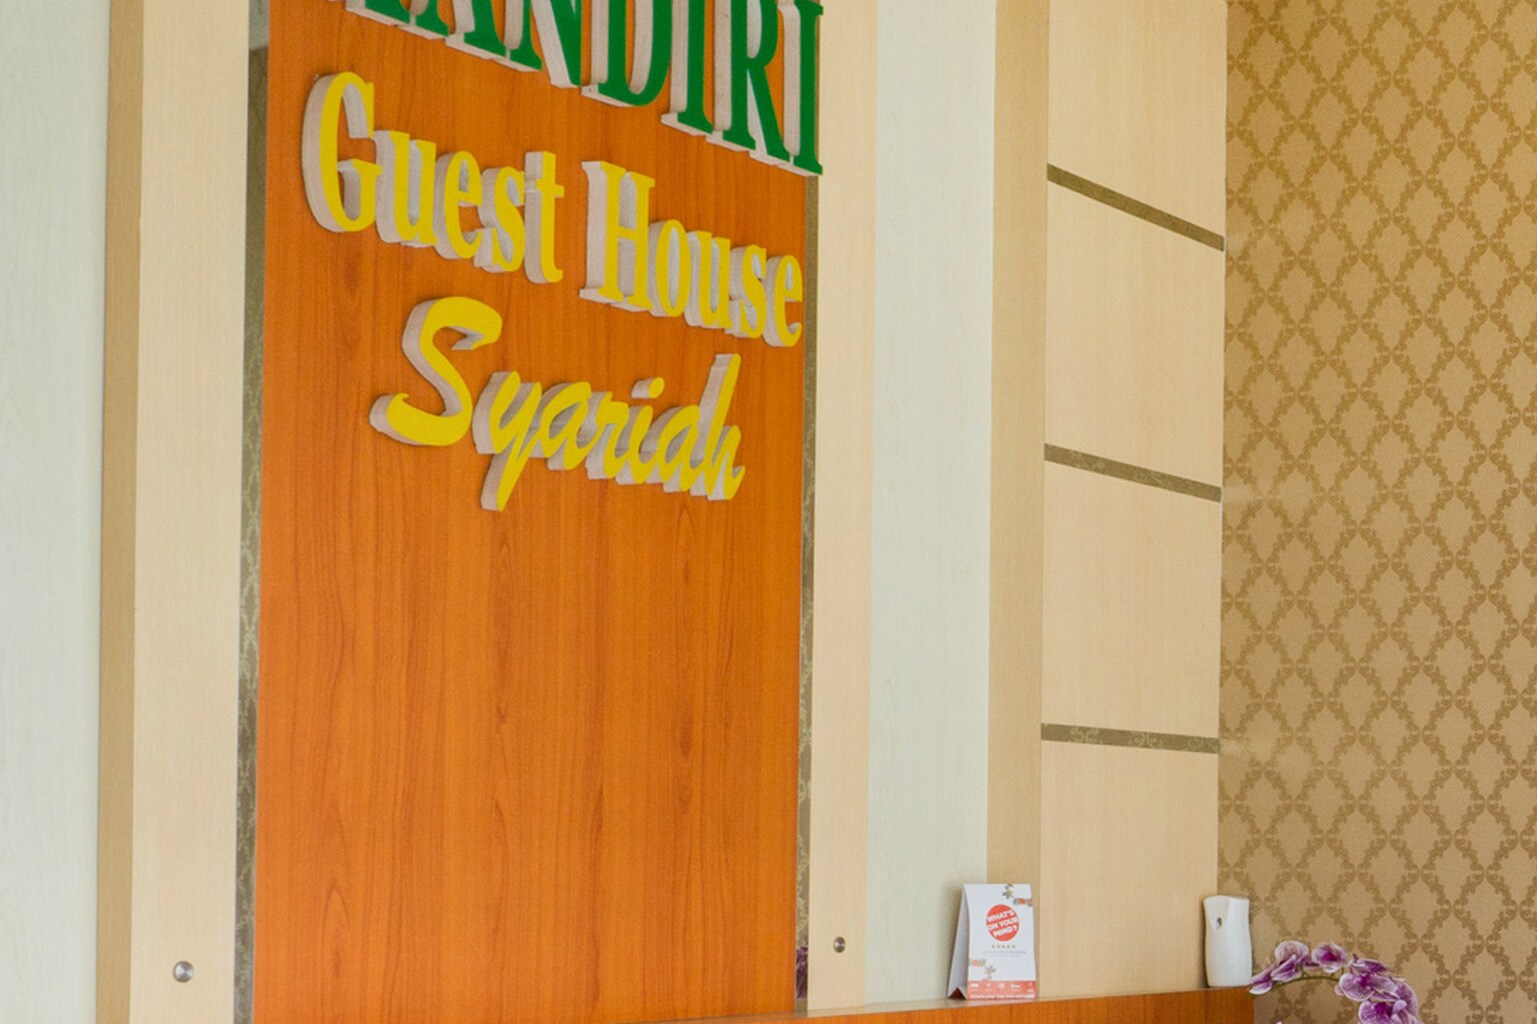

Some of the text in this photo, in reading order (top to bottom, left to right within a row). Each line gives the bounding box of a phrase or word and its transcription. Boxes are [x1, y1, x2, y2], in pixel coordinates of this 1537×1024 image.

[302, 71, 803, 347] Guest House
[369, 296, 746, 512] Syariah
